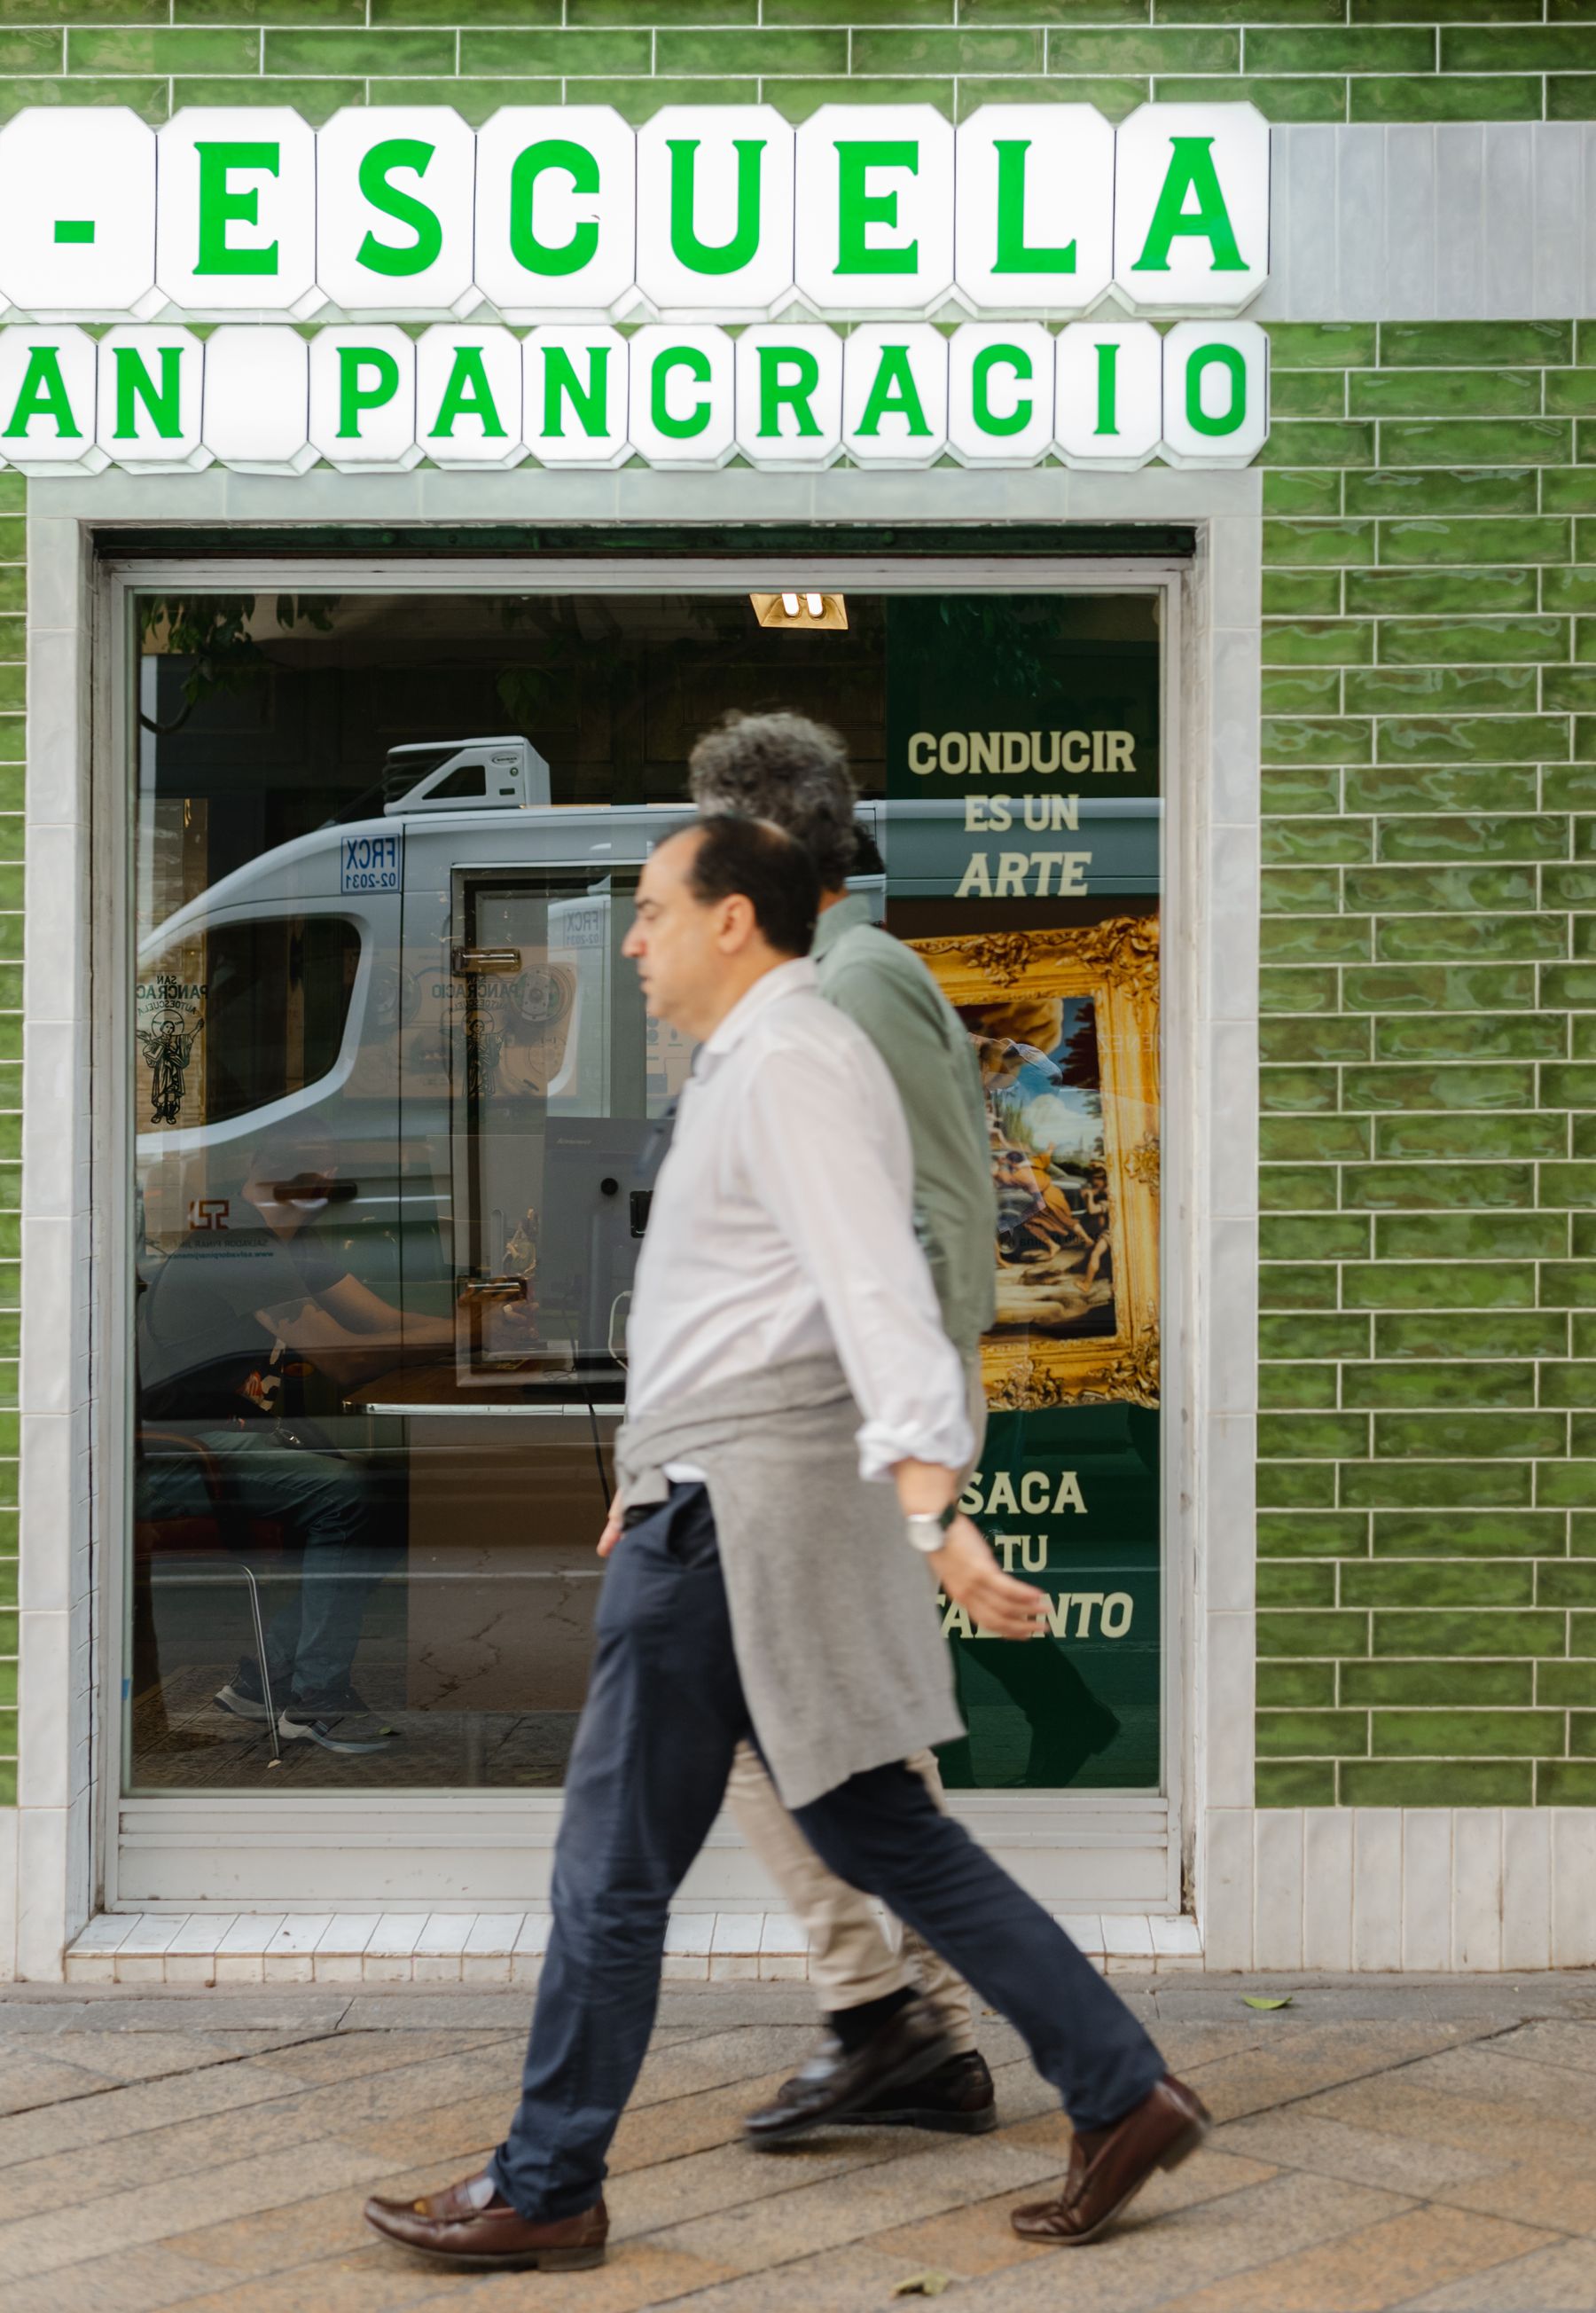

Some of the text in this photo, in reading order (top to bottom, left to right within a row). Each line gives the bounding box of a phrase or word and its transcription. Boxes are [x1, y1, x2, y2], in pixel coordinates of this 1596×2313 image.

[192, 137, 1250, 277] ESCUELA
[336, 343, 1248, 439] PANCRACIO
[908, 731, 1136, 774] CONDUCIR
[965, 794, 1080, 832] ES UN
[954, 851, 1092, 898] ARTE
[958, 1470, 1088, 1515] SACA
[995, 1534, 1048, 1572] TU
[936, 1592, 1133, 1639] ANTO
